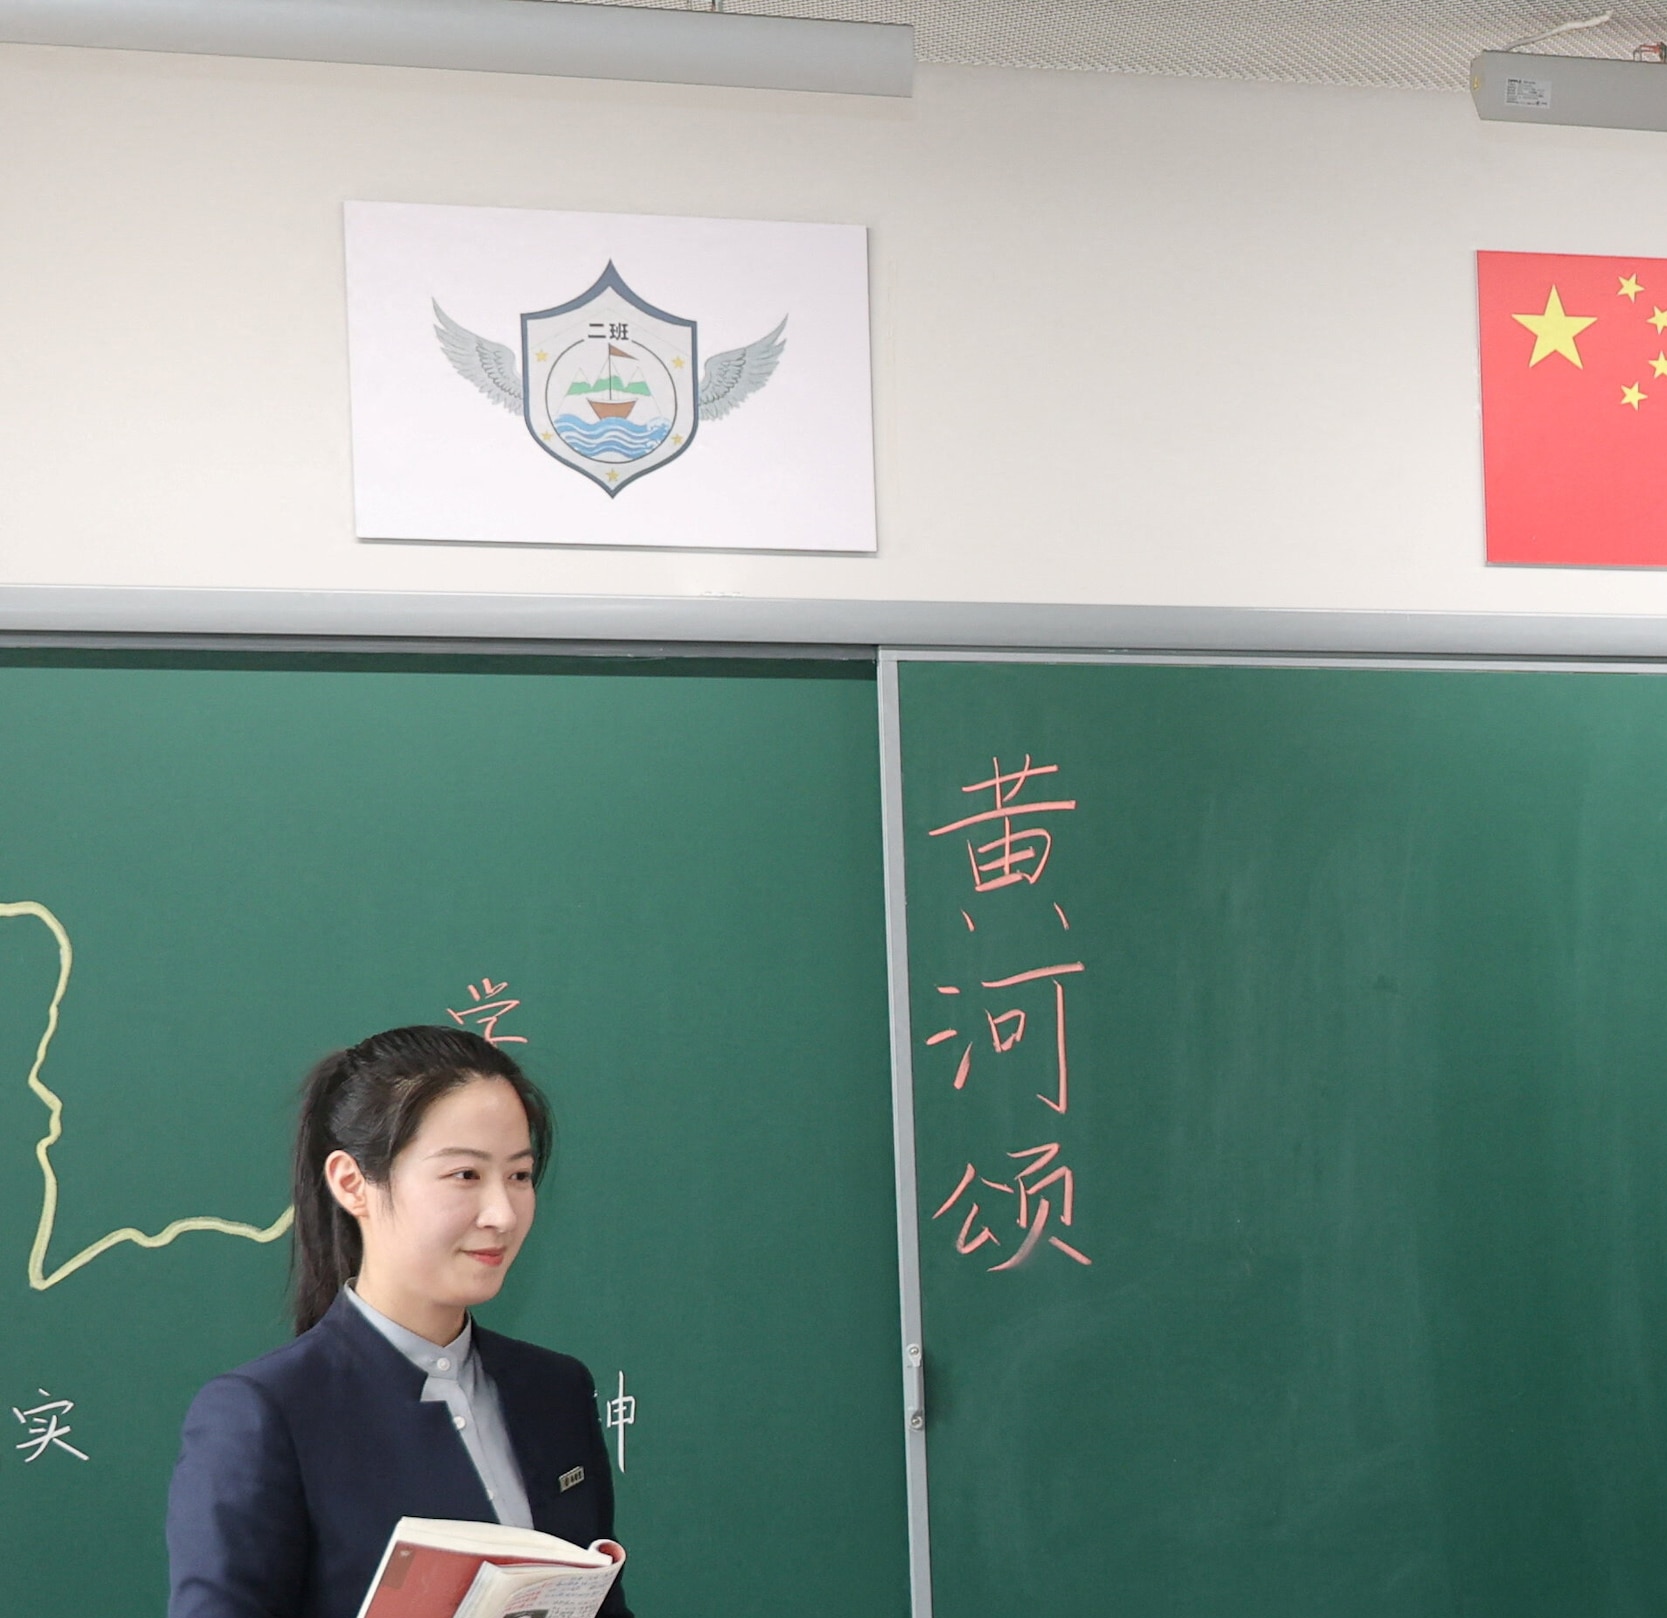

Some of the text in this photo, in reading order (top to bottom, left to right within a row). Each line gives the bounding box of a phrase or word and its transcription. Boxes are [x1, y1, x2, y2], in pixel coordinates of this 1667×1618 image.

[588, 322, 629, 341] 二班
[927, 753, 1092, 1272] 黄河颂
[12, 1388, 89, 1463] 实
